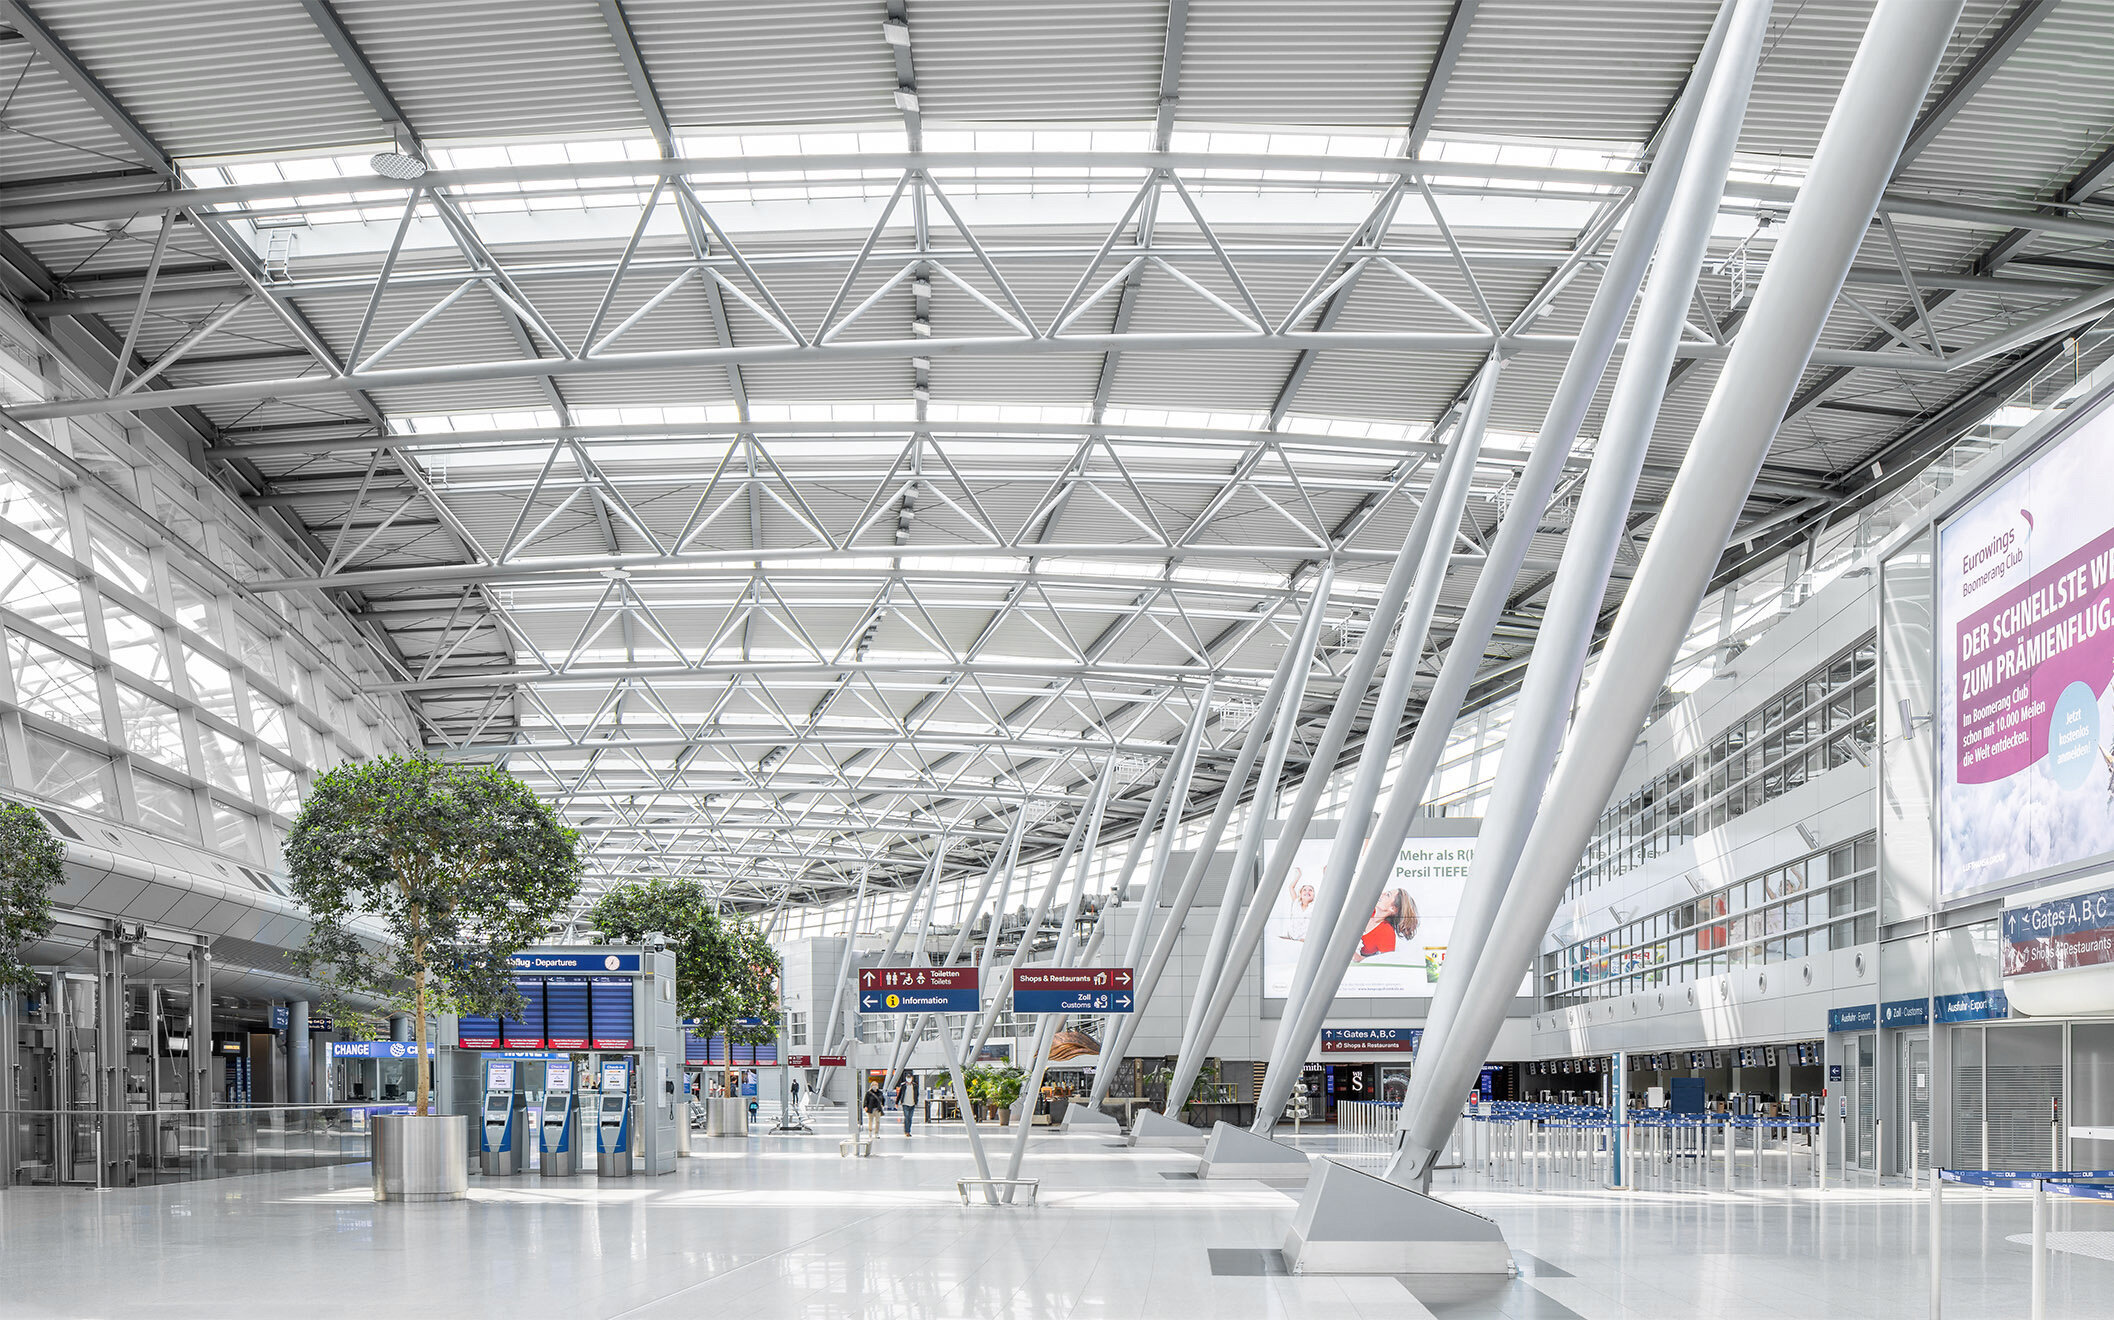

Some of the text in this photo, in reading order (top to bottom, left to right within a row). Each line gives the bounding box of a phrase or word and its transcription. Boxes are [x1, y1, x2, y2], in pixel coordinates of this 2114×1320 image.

[1963, 528, 2015, 575] Eurowings
[1963, 548, 2024, 597] Boomerang Club
[1963, 622, 1990, 661] DER
[1993, 563, 2088, 645] SCHNELLSTE
[1962, 597, 2114, 701] ZUM PRÄMIENFLUG.
[1963, 684, 2029, 728] Im Boomerang Club
[1963, 700, 2046, 748] schon mit 10.000 Meilen
[2066, 708, 2082, 725] Jetzt
[2059, 725, 2090, 747] kostenlos
[1963, 731, 2029, 768] die Welt entdecken.
[2057, 741, 2091, 765] anmelden!
[1400, 850, 1433, 861] Mehr
[1436, 849, 1454, 861] als
[1396, 866, 1468, 878] Persil TIEFE
[2032, 896, 2107, 930] Gates A,B,C
[2063, 937, 2112, 956] Restaurants
[535, 958, 577, 968] Departures
[1020, 974, 1042, 983] Shops
[902, 996, 949, 1005] Information
[1061, 1001, 1091, 1009] Customs
[1948, 999, 1988, 1013] Ausfuhr Export
[1841, 1011, 1871, 1023] Ausfuhr Export
[1893, 1007, 1923, 1018] Zoll Customs
[1343, 1030, 1396, 1039] Gates A,B,C
[334, 1044, 369, 1055] CHANGE
[1303, 1062, 1322, 1071] mith
[1352, 1076, 1363, 1091] S
